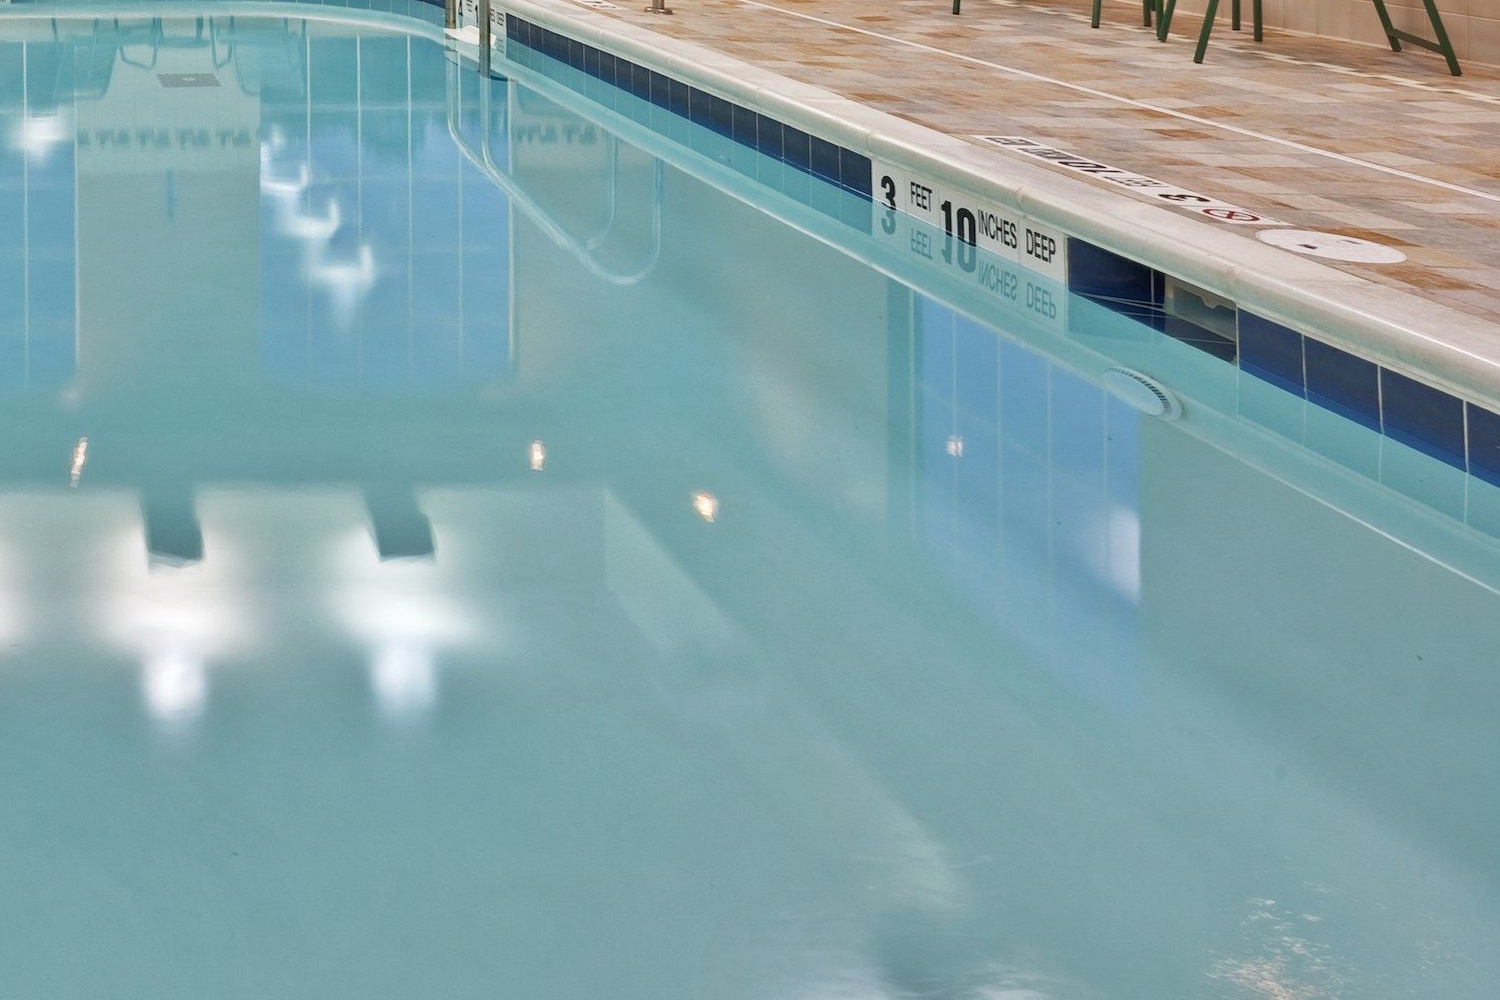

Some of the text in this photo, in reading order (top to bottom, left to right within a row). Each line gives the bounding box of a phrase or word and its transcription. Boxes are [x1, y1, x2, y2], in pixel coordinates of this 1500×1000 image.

[881, 175, 1056, 264] 3 FEET 10 INCHES DEEP
